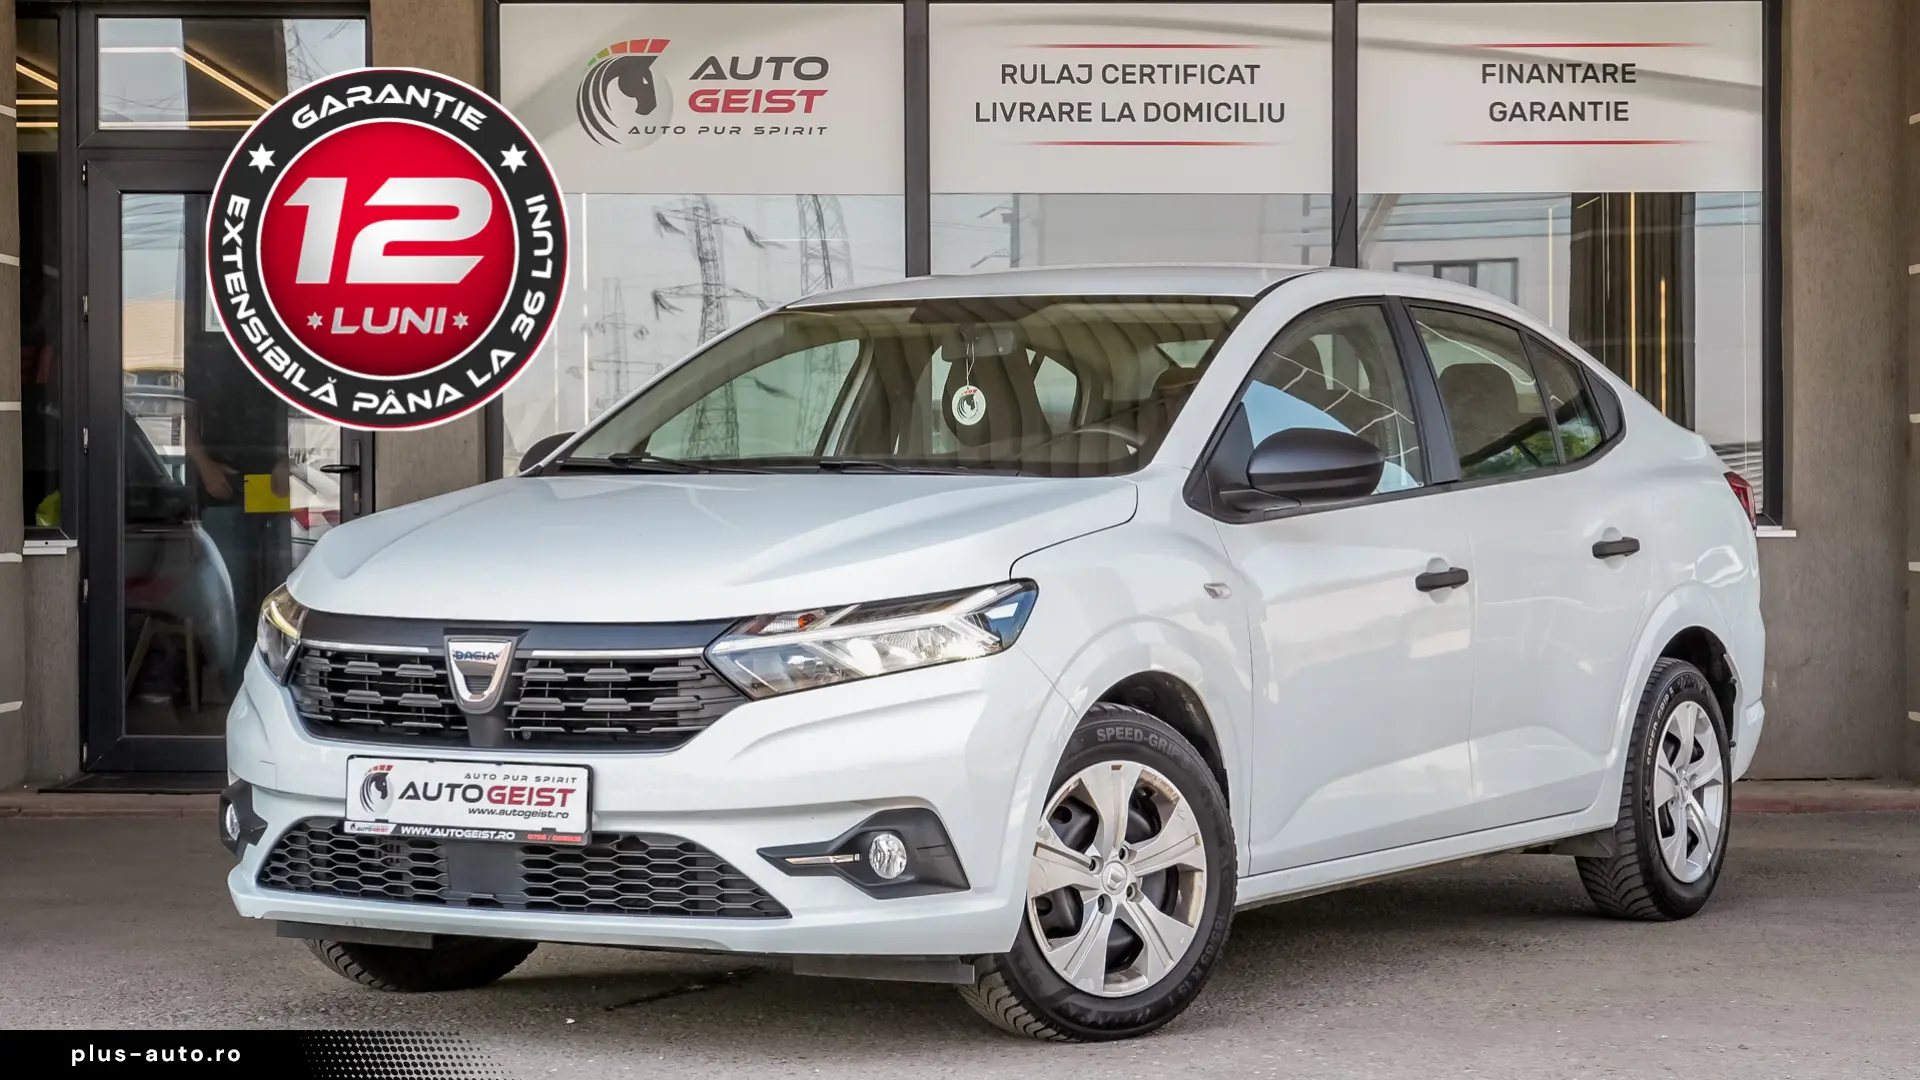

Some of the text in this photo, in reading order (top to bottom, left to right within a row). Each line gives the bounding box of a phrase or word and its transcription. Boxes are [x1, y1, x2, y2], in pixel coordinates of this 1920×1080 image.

[688, 55, 830, 81] AUTO
[1000, 63, 1261, 85] RULAJ CERTIFICAT
[1481, 63, 1637, 84] FINANTARE
[688, 88, 829, 114] GEIST
[974, 101, 1286, 123] LIVRARE LA DOMICILIU
[1488, 101, 1630, 123] GARANTIE
[628, 125, 828, 136] AUTO PUR SPIRIT
[455, 650, 497, 661] DACIA
[1096, 726, 1183, 758] SPEED-GRIP
[464, 772, 578, 784] AUTO PUR SPIRIT
[468, 807, 570, 820] www.autogeist.ro
[400, 825, 516, 840] WWW.AUTOGEIST.RO
